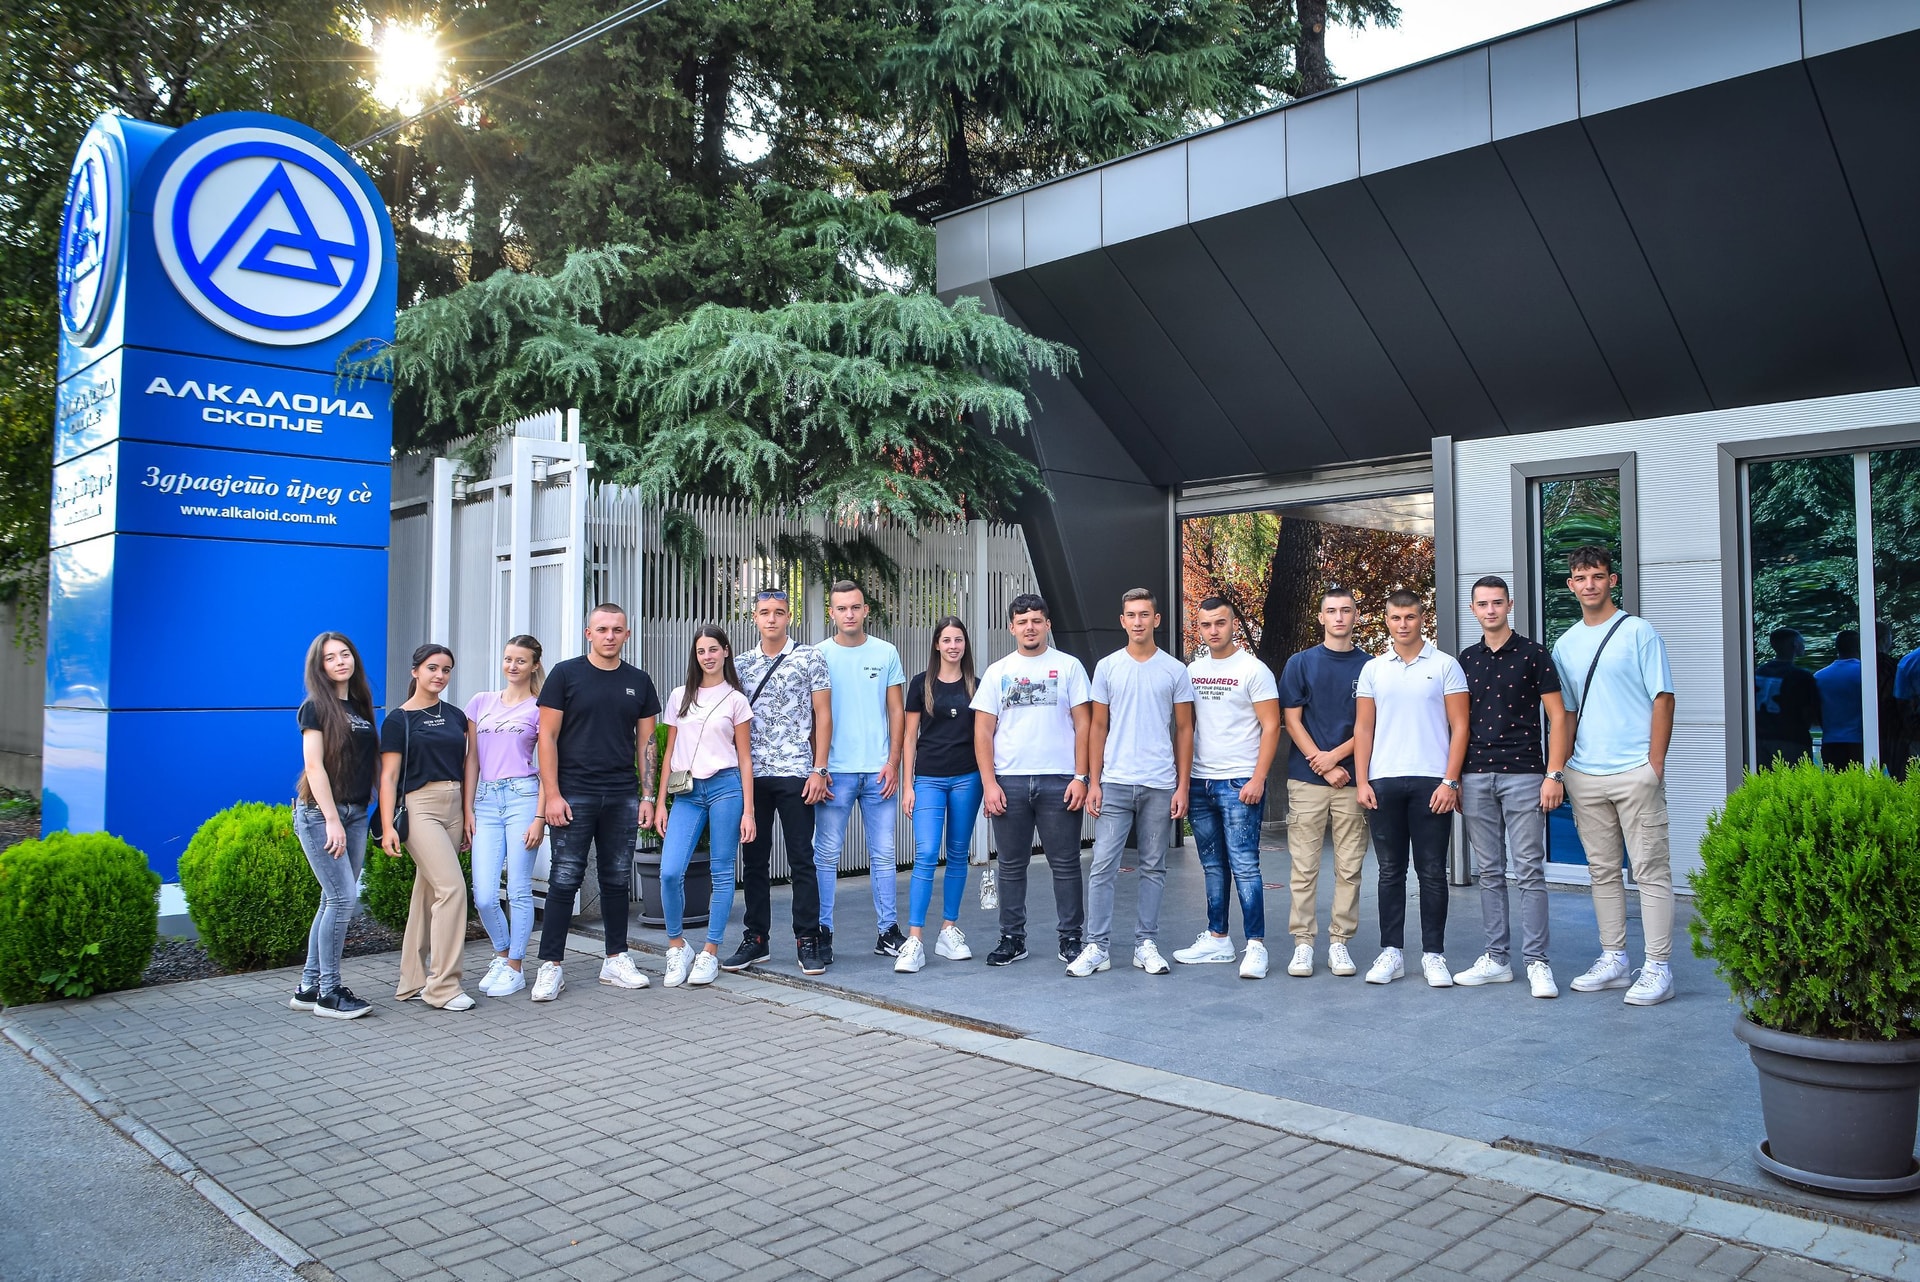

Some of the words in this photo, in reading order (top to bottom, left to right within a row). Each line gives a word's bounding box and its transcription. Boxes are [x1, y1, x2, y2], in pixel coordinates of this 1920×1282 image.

[144, 376, 375, 420] АЛКАЛОИД
[202, 407, 323, 434] СКОПЈЕ
[180, 505, 338, 526] www.alkaloid.com.mk
[1191, 678, 1239, 686] DSQUARED2
